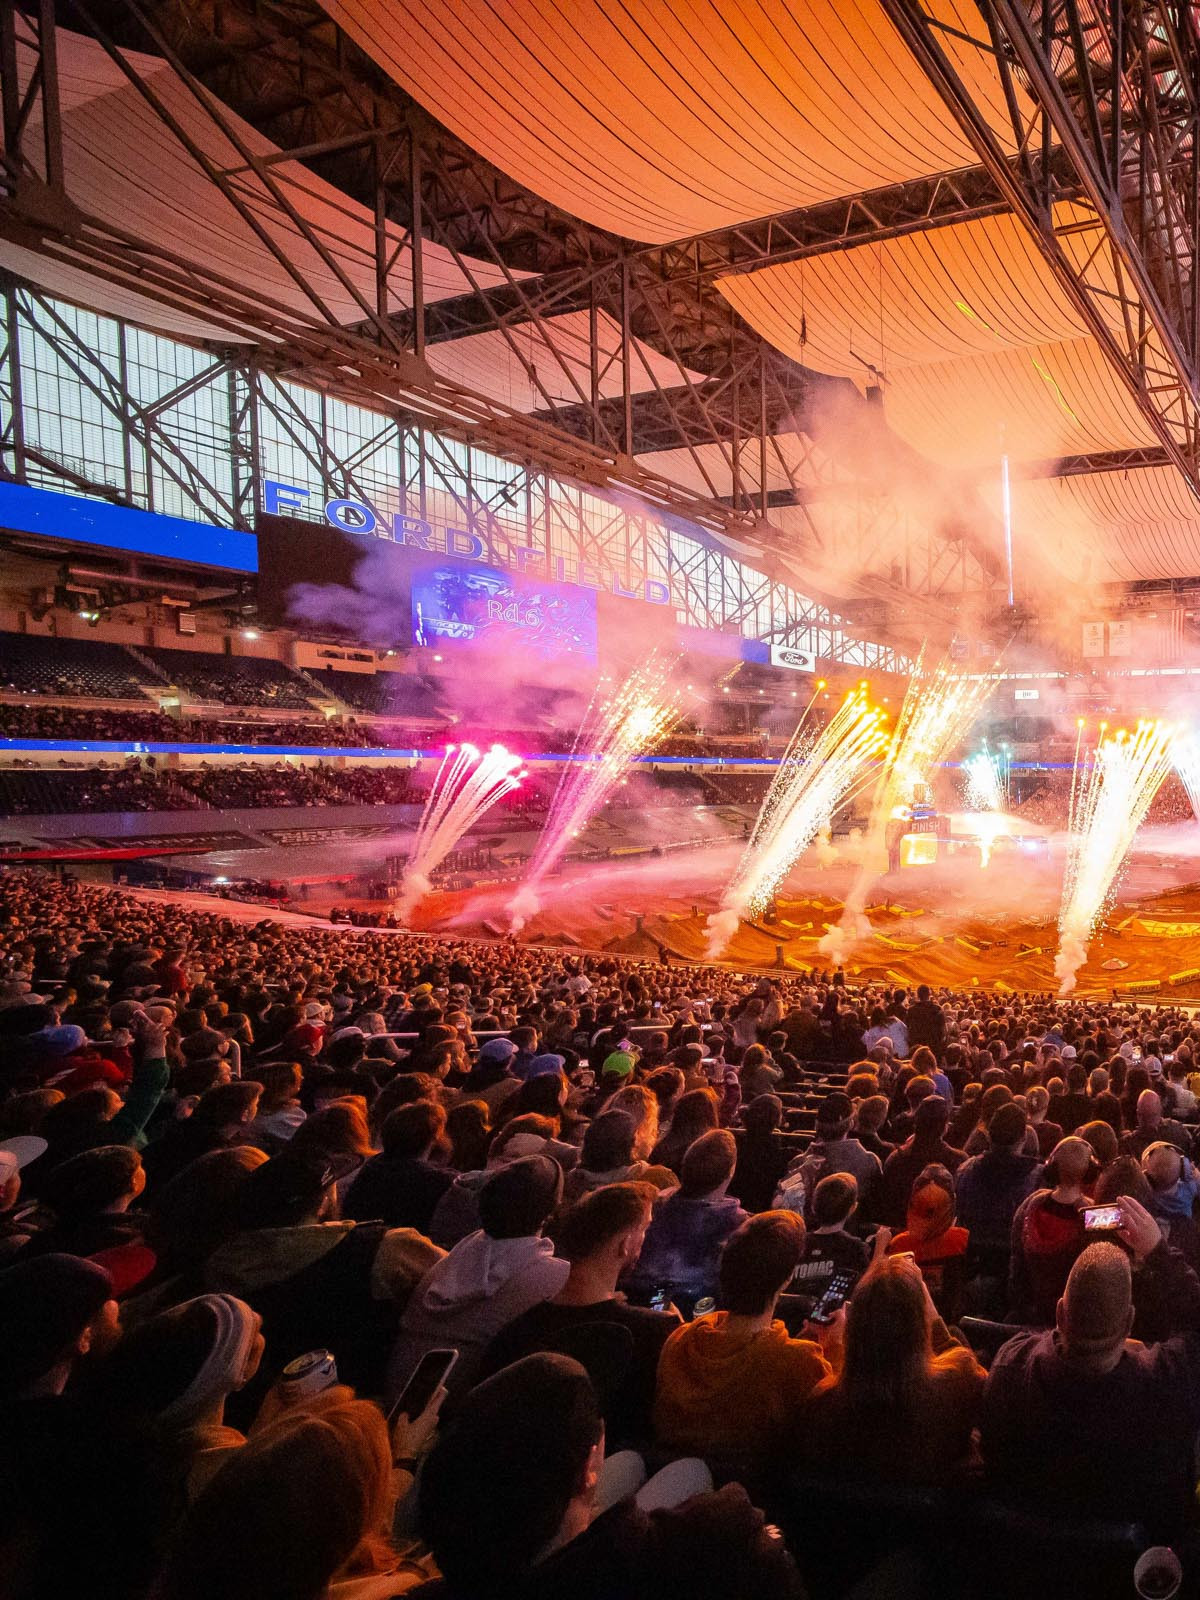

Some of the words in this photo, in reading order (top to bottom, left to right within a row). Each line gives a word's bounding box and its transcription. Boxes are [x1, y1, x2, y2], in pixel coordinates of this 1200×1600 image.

[261, 478, 483, 561] FORD
[516, 545, 670, 605] FIELD
[487, 599, 542, 627] Rd.6
[911, 821, 939, 832] FINISH
[794, 1260, 834, 1279] TOMAC
